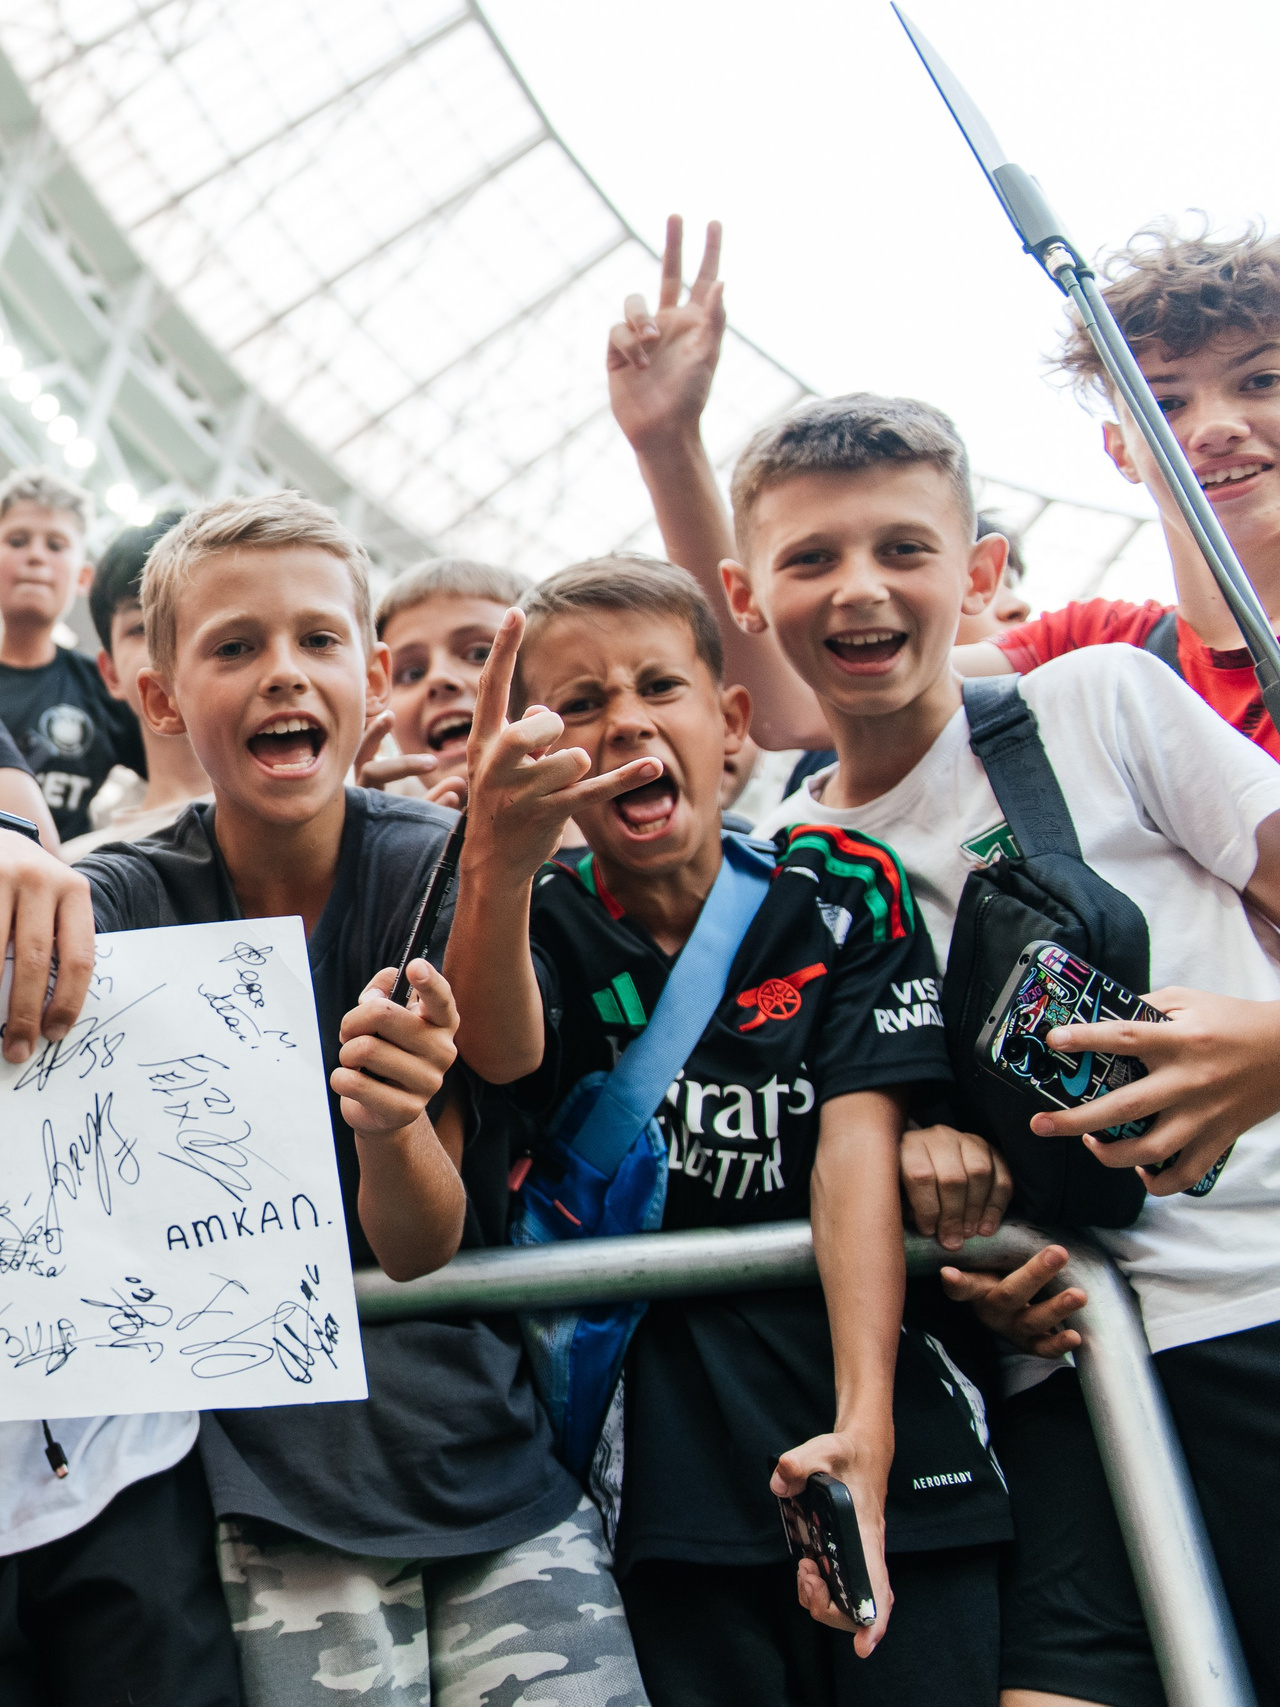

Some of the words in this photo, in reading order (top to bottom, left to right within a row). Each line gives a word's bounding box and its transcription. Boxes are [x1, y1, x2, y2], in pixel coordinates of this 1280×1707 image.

[35, 770, 91, 812] ET
[890, 977, 940, 1005] VIS
[872, 1002, 945, 1034] RWA
[912, 1470, 973, 1490] AEROREADY
